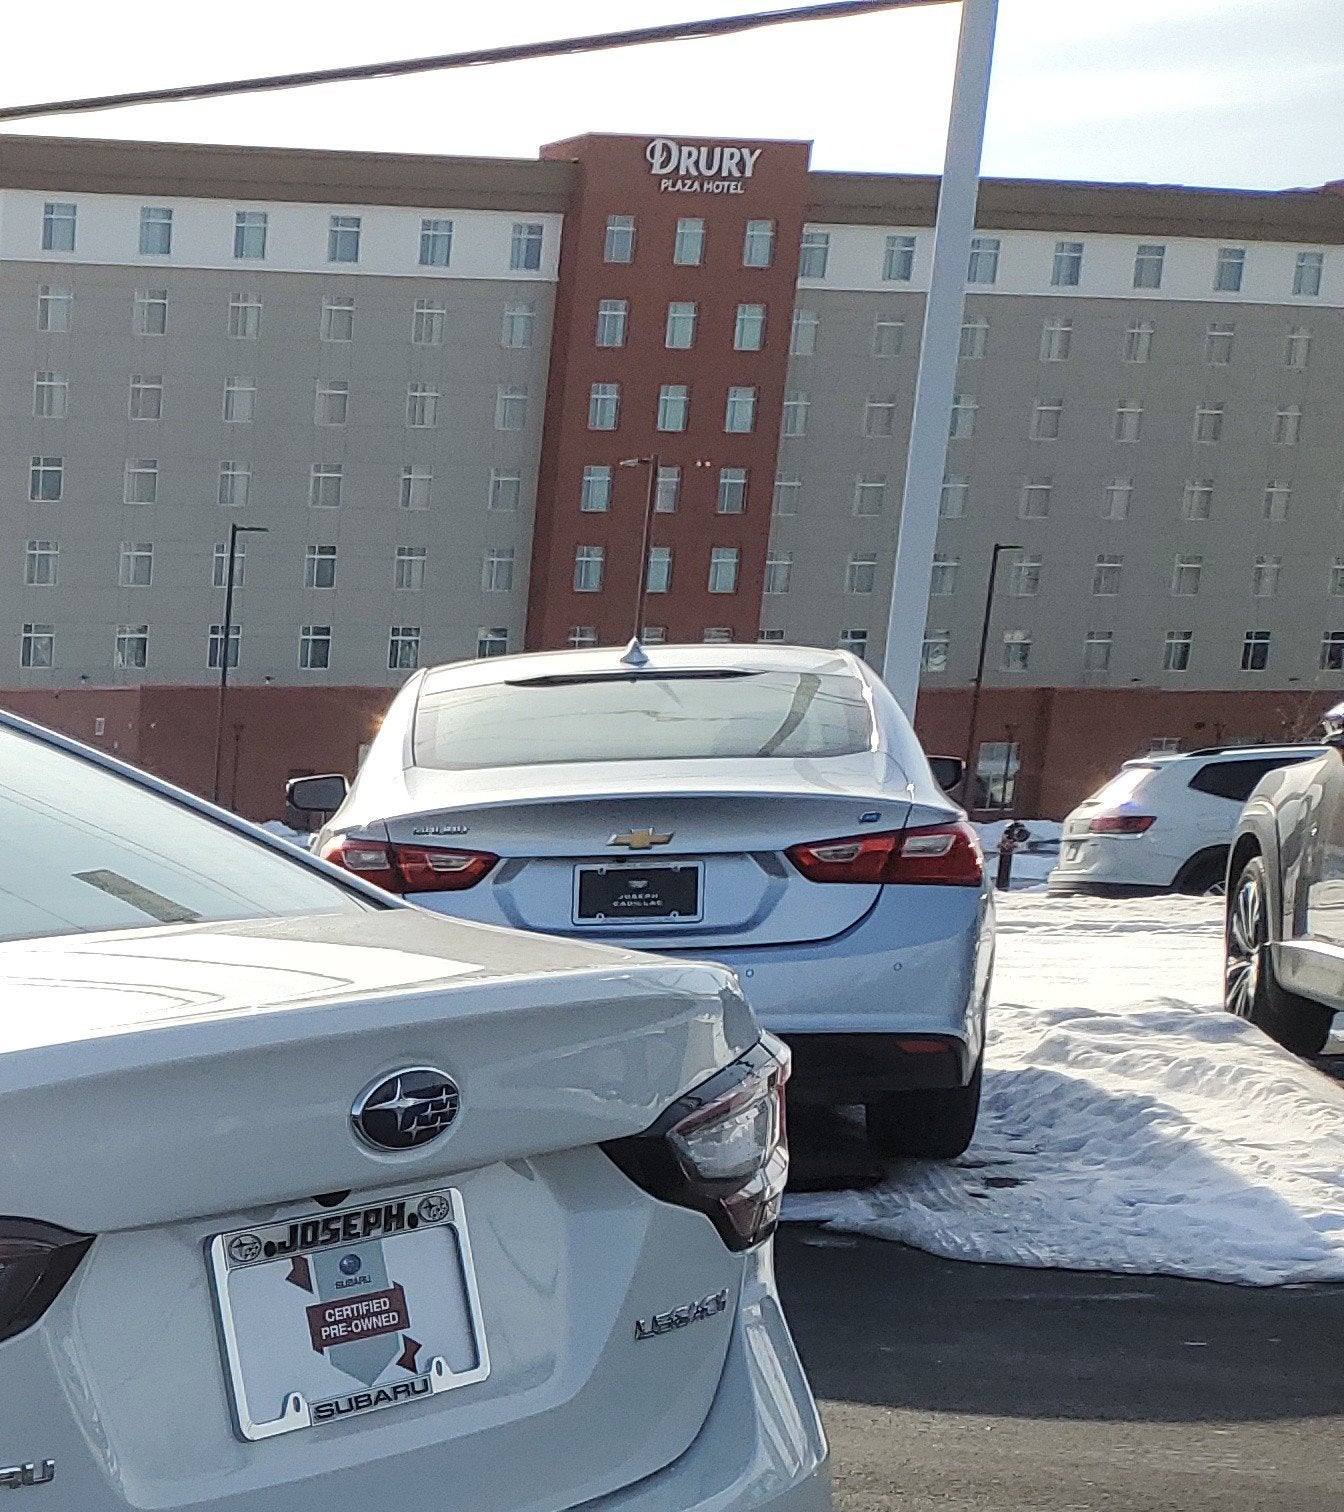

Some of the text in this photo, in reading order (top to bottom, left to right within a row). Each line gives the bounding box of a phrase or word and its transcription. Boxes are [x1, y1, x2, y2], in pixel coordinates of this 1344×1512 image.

[646, 138, 762, 177] DRURY
[661, 179, 745, 195] PLAZA HOTEL
[277, 1202, 406, 1253] JOSEPH
[321, 1312, 399, 1340] PRE-OWNED
[325, 1297, 390, 1323] CERTIFIED
[313, 1377, 430, 1420] SUBARU
